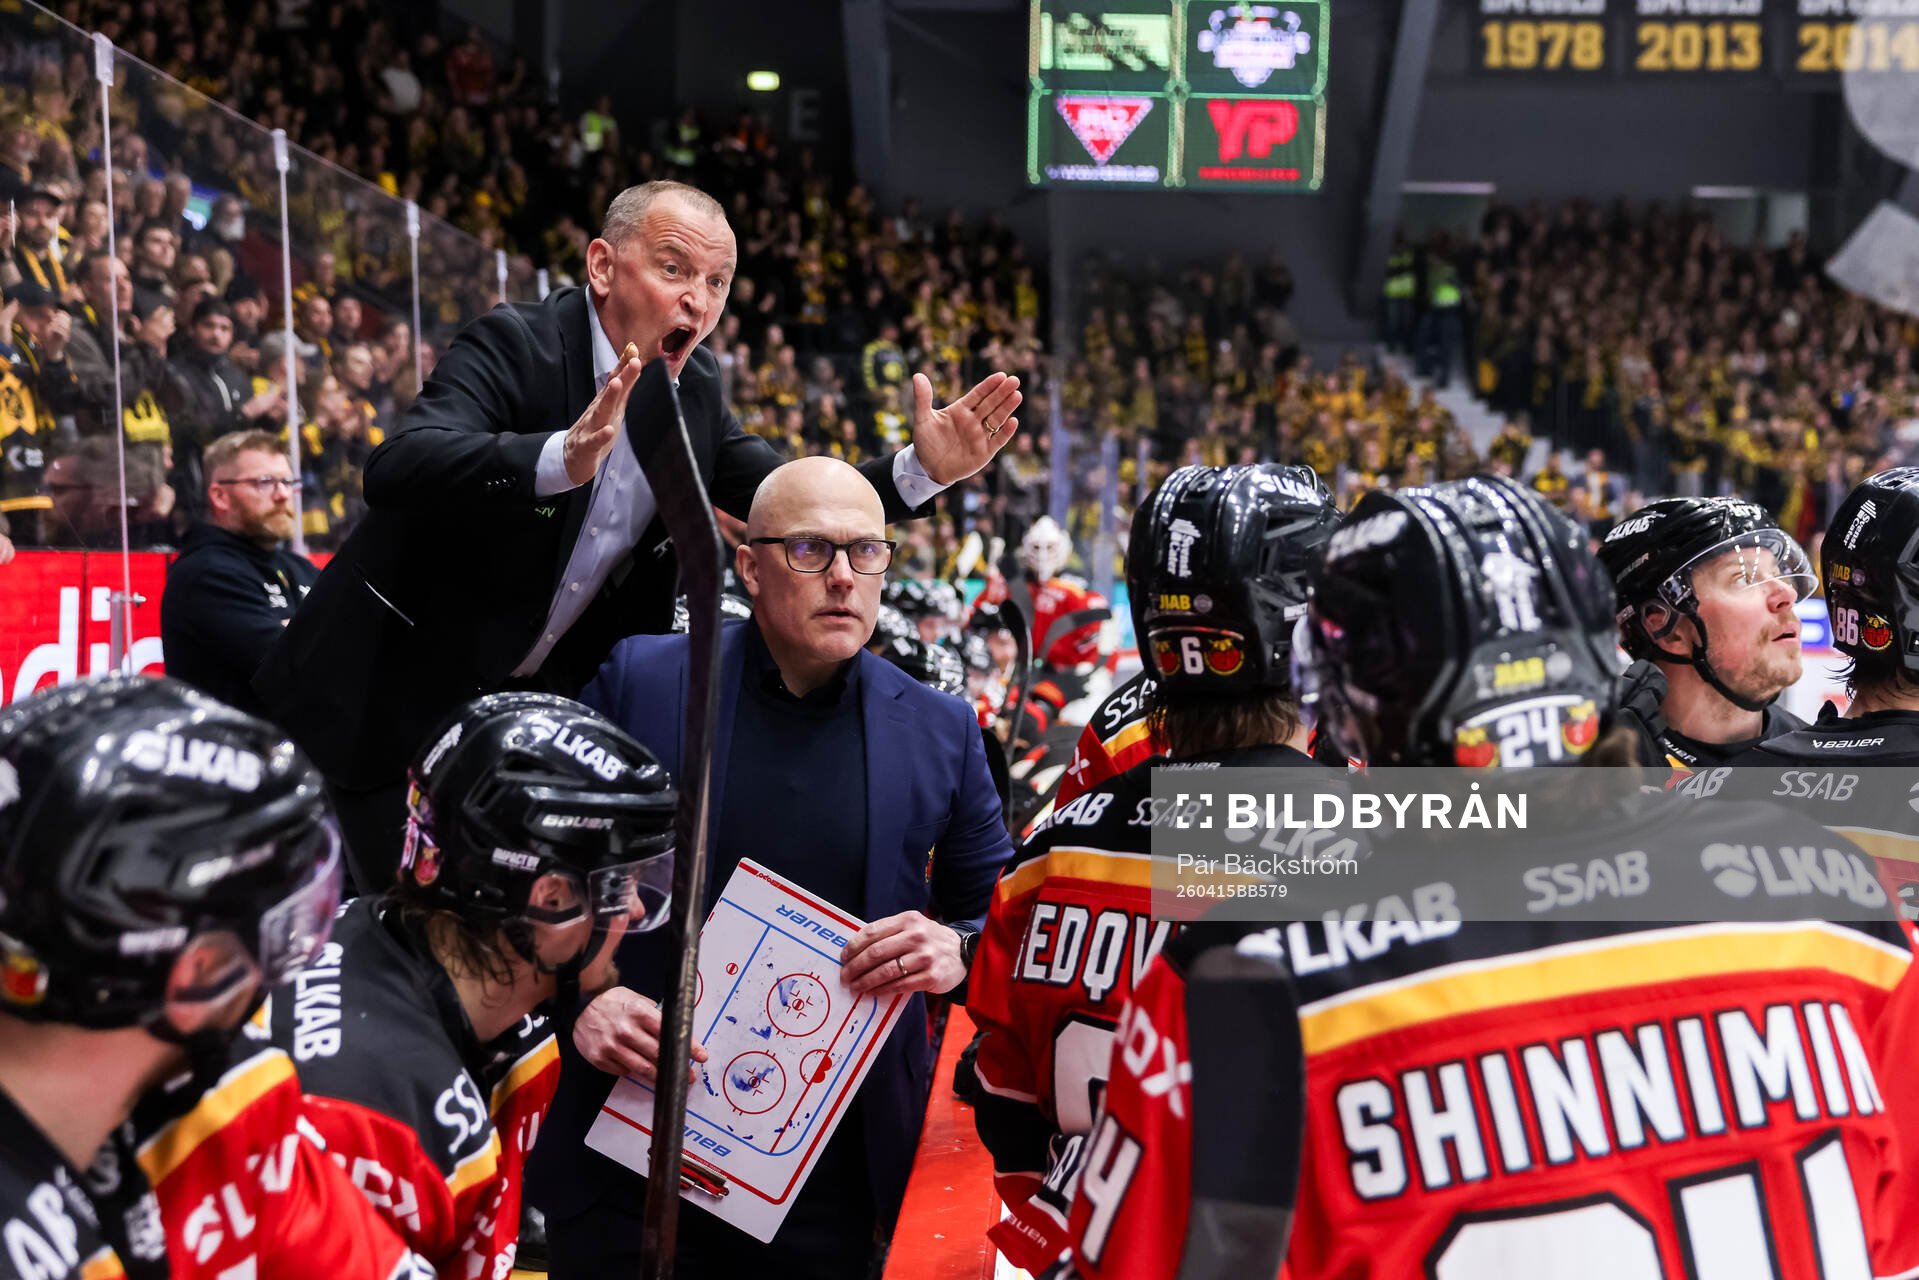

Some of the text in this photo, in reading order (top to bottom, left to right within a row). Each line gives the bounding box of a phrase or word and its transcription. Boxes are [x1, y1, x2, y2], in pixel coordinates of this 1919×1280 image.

[1482, 22, 1604, 70] 1978
[1636, 23, 1763, 72] 2013
[1797, 23, 1919, 72] 2014
[1843, 518, 1860, 547] Cater
[1848, 512, 1871, 551] Svensk
[1836, 607, 1859, 646] 86
[1180, 636, 1204, 675] 6
[552, 726, 625, 782] LKAB
[1496, 706, 1563, 771] 24
[1822, 737, 1885, 749] BAUER
[165, 734, 264, 792] LKAB
[1772, 770, 1859, 800] SSAB
[1522, 850, 1650, 913] SSAB
[774, 903, 850, 948] BAUER
[1286, 880, 1462, 977] LKAB
[1013, 903, 1171, 1002] EDQV
[294, 967, 343, 1063] LKAB
[684, 1126, 732, 1158] BAU
